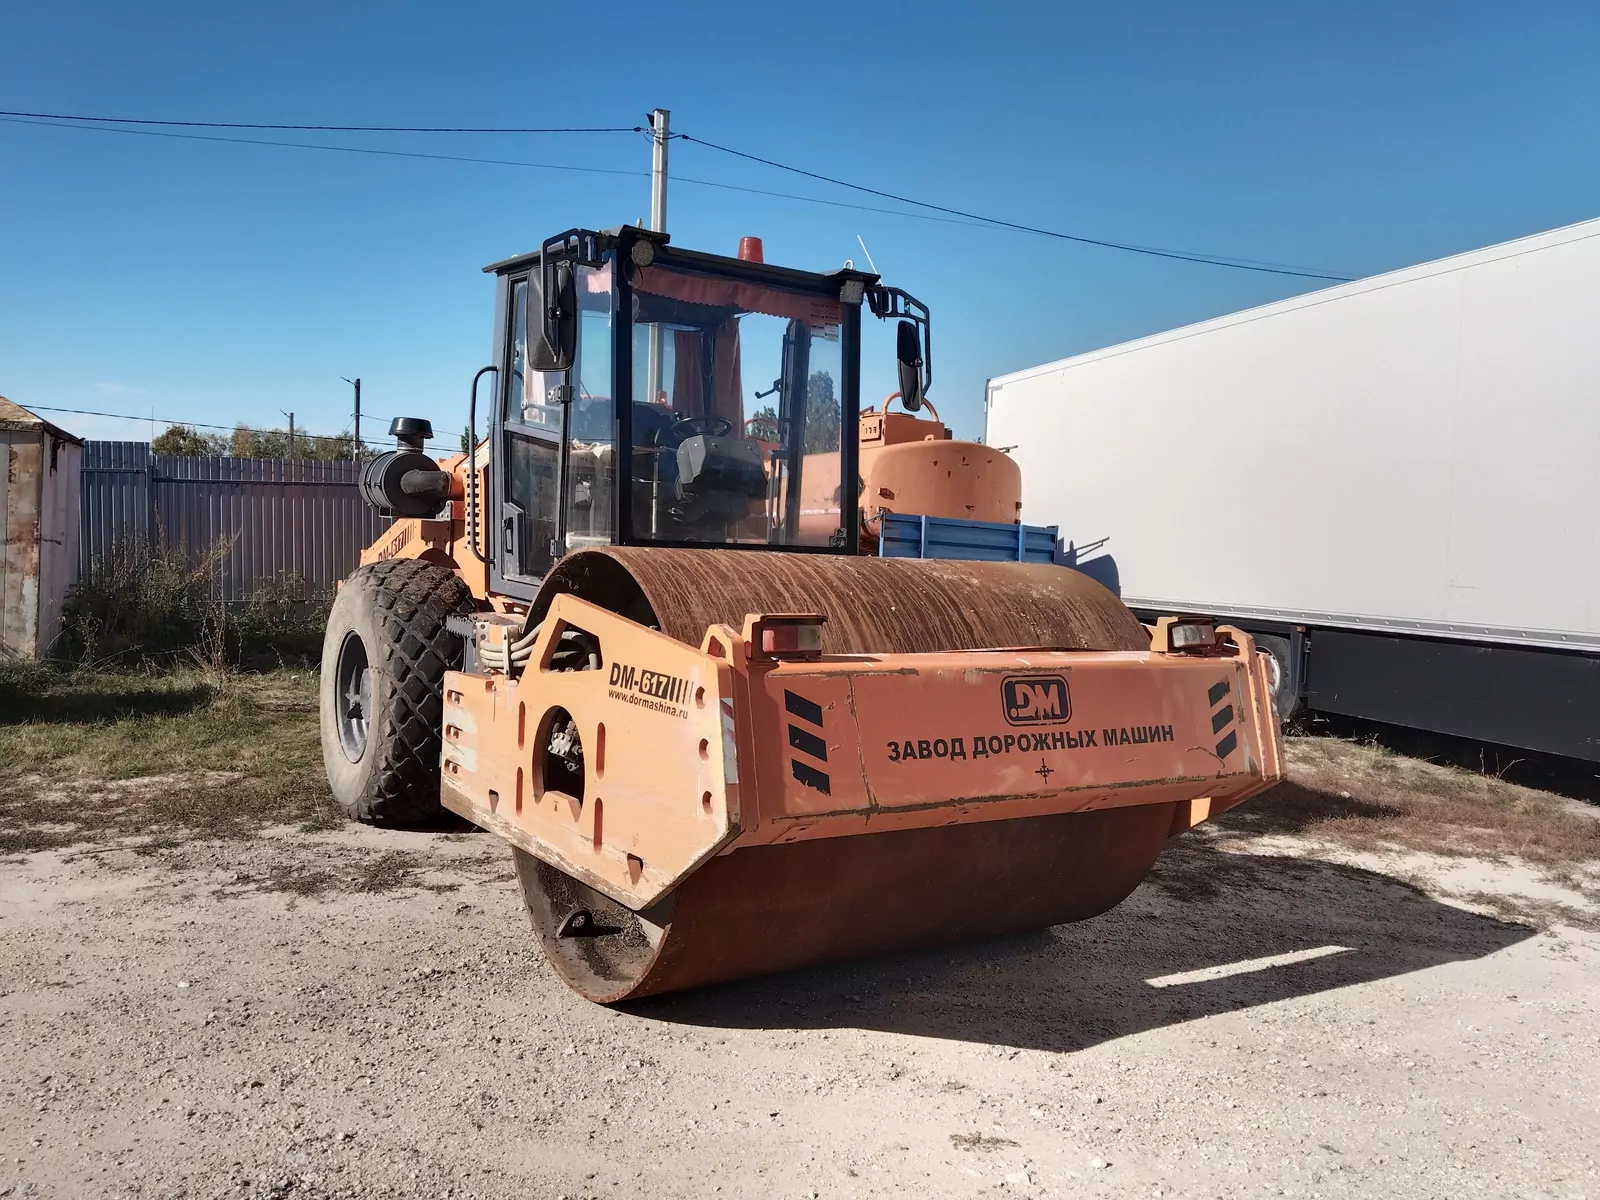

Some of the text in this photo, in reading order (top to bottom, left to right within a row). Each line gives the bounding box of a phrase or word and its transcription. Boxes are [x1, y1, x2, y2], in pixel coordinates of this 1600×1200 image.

[609, 662, 671, 700] DM-617
[609, 689, 688, 719] www.dormashina.ru
[1005, 680, 1066, 722] DM
[887, 725, 1175, 762] ЗАВОД ДОРОЖНЫХ МАШИН
